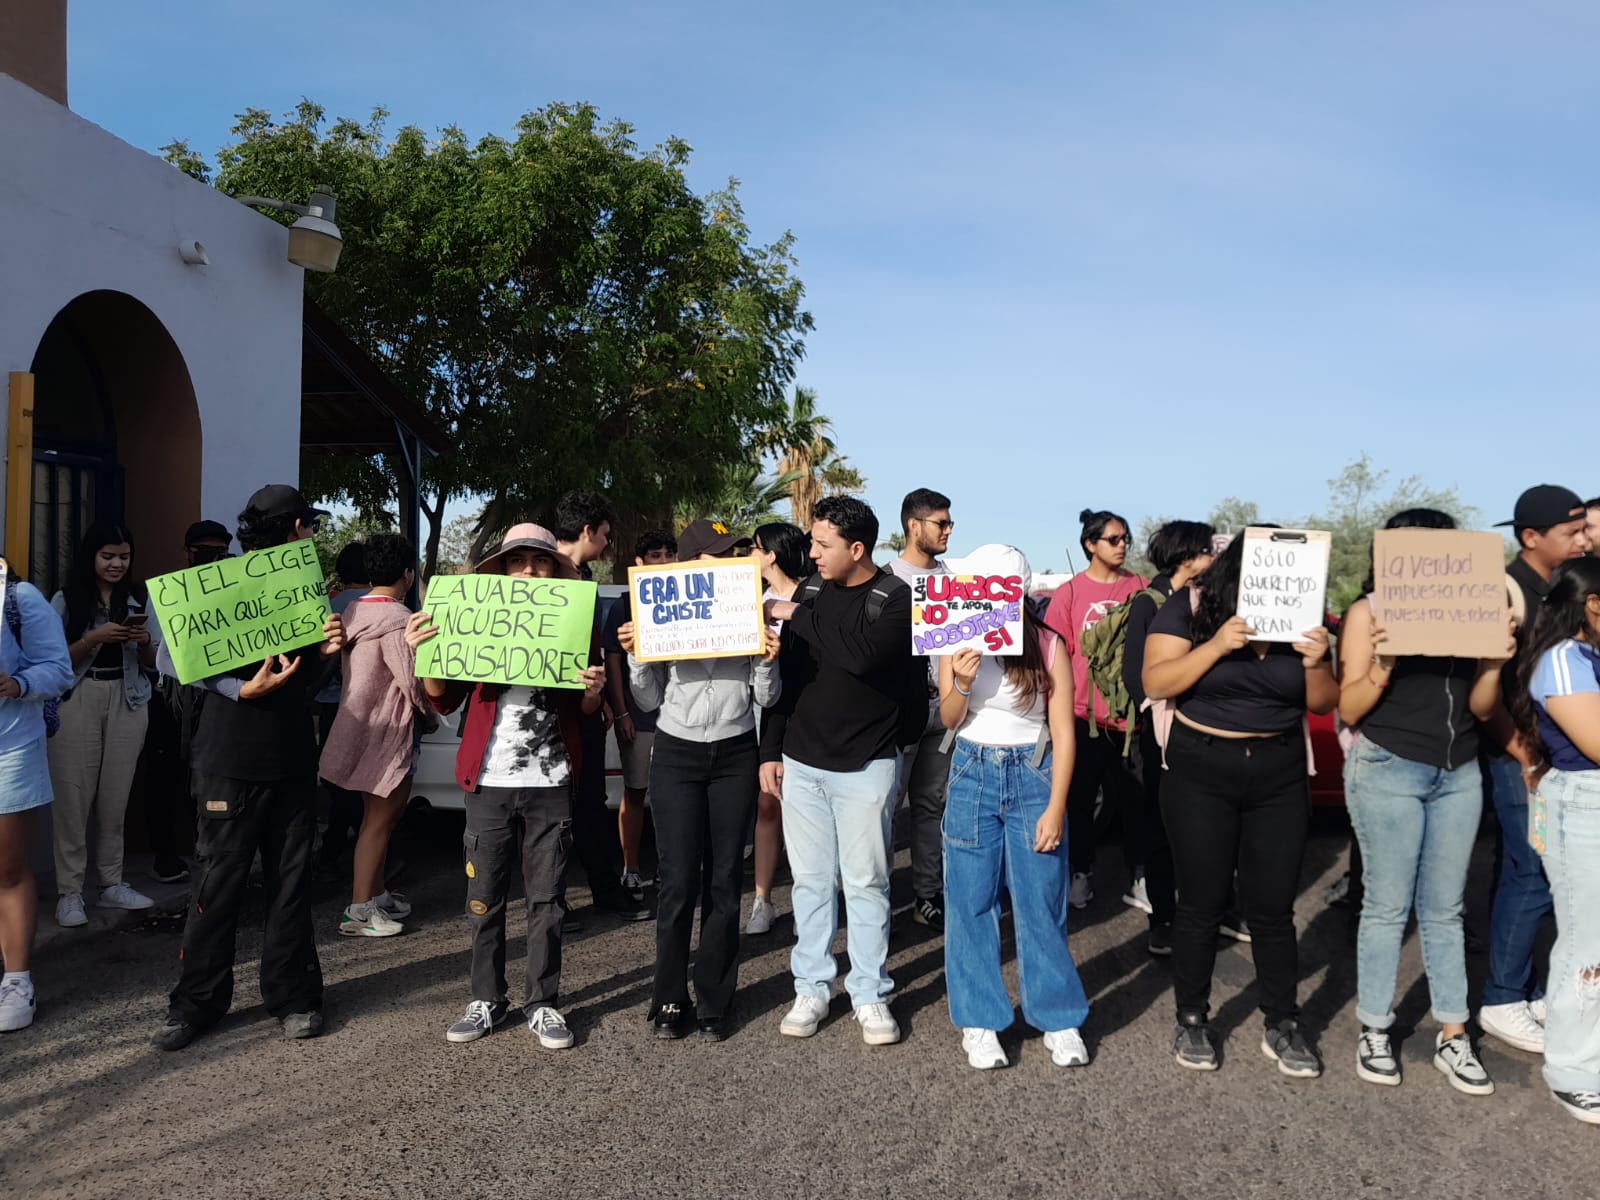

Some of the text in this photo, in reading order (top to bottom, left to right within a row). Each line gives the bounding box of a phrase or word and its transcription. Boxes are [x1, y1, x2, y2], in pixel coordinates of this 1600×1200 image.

[159, 545, 316, 607] ¿Y EL CIGE
[684, 571, 715, 600] UN
[926, 575, 1023, 602] UABCS
[1243, 574, 1317, 594] QUEREMOS
[428, 577, 569, 607] LA UABCS
[1274, 595, 1303, 609] NOS
[168, 581, 328, 647] PARA QUÉ SIRVE
[946, 601, 959, 610] TE
[961, 601, 993, 612] APOYA
[1384, 606, 1501, 624] nuestra verdad
[203, 605, 327, 667] ENTONCES?
[1245, 614, 1293, 633] CREAN
[984, 626, 1014, 651] SI
[429, 642, 588, 684] ABUSADORES
